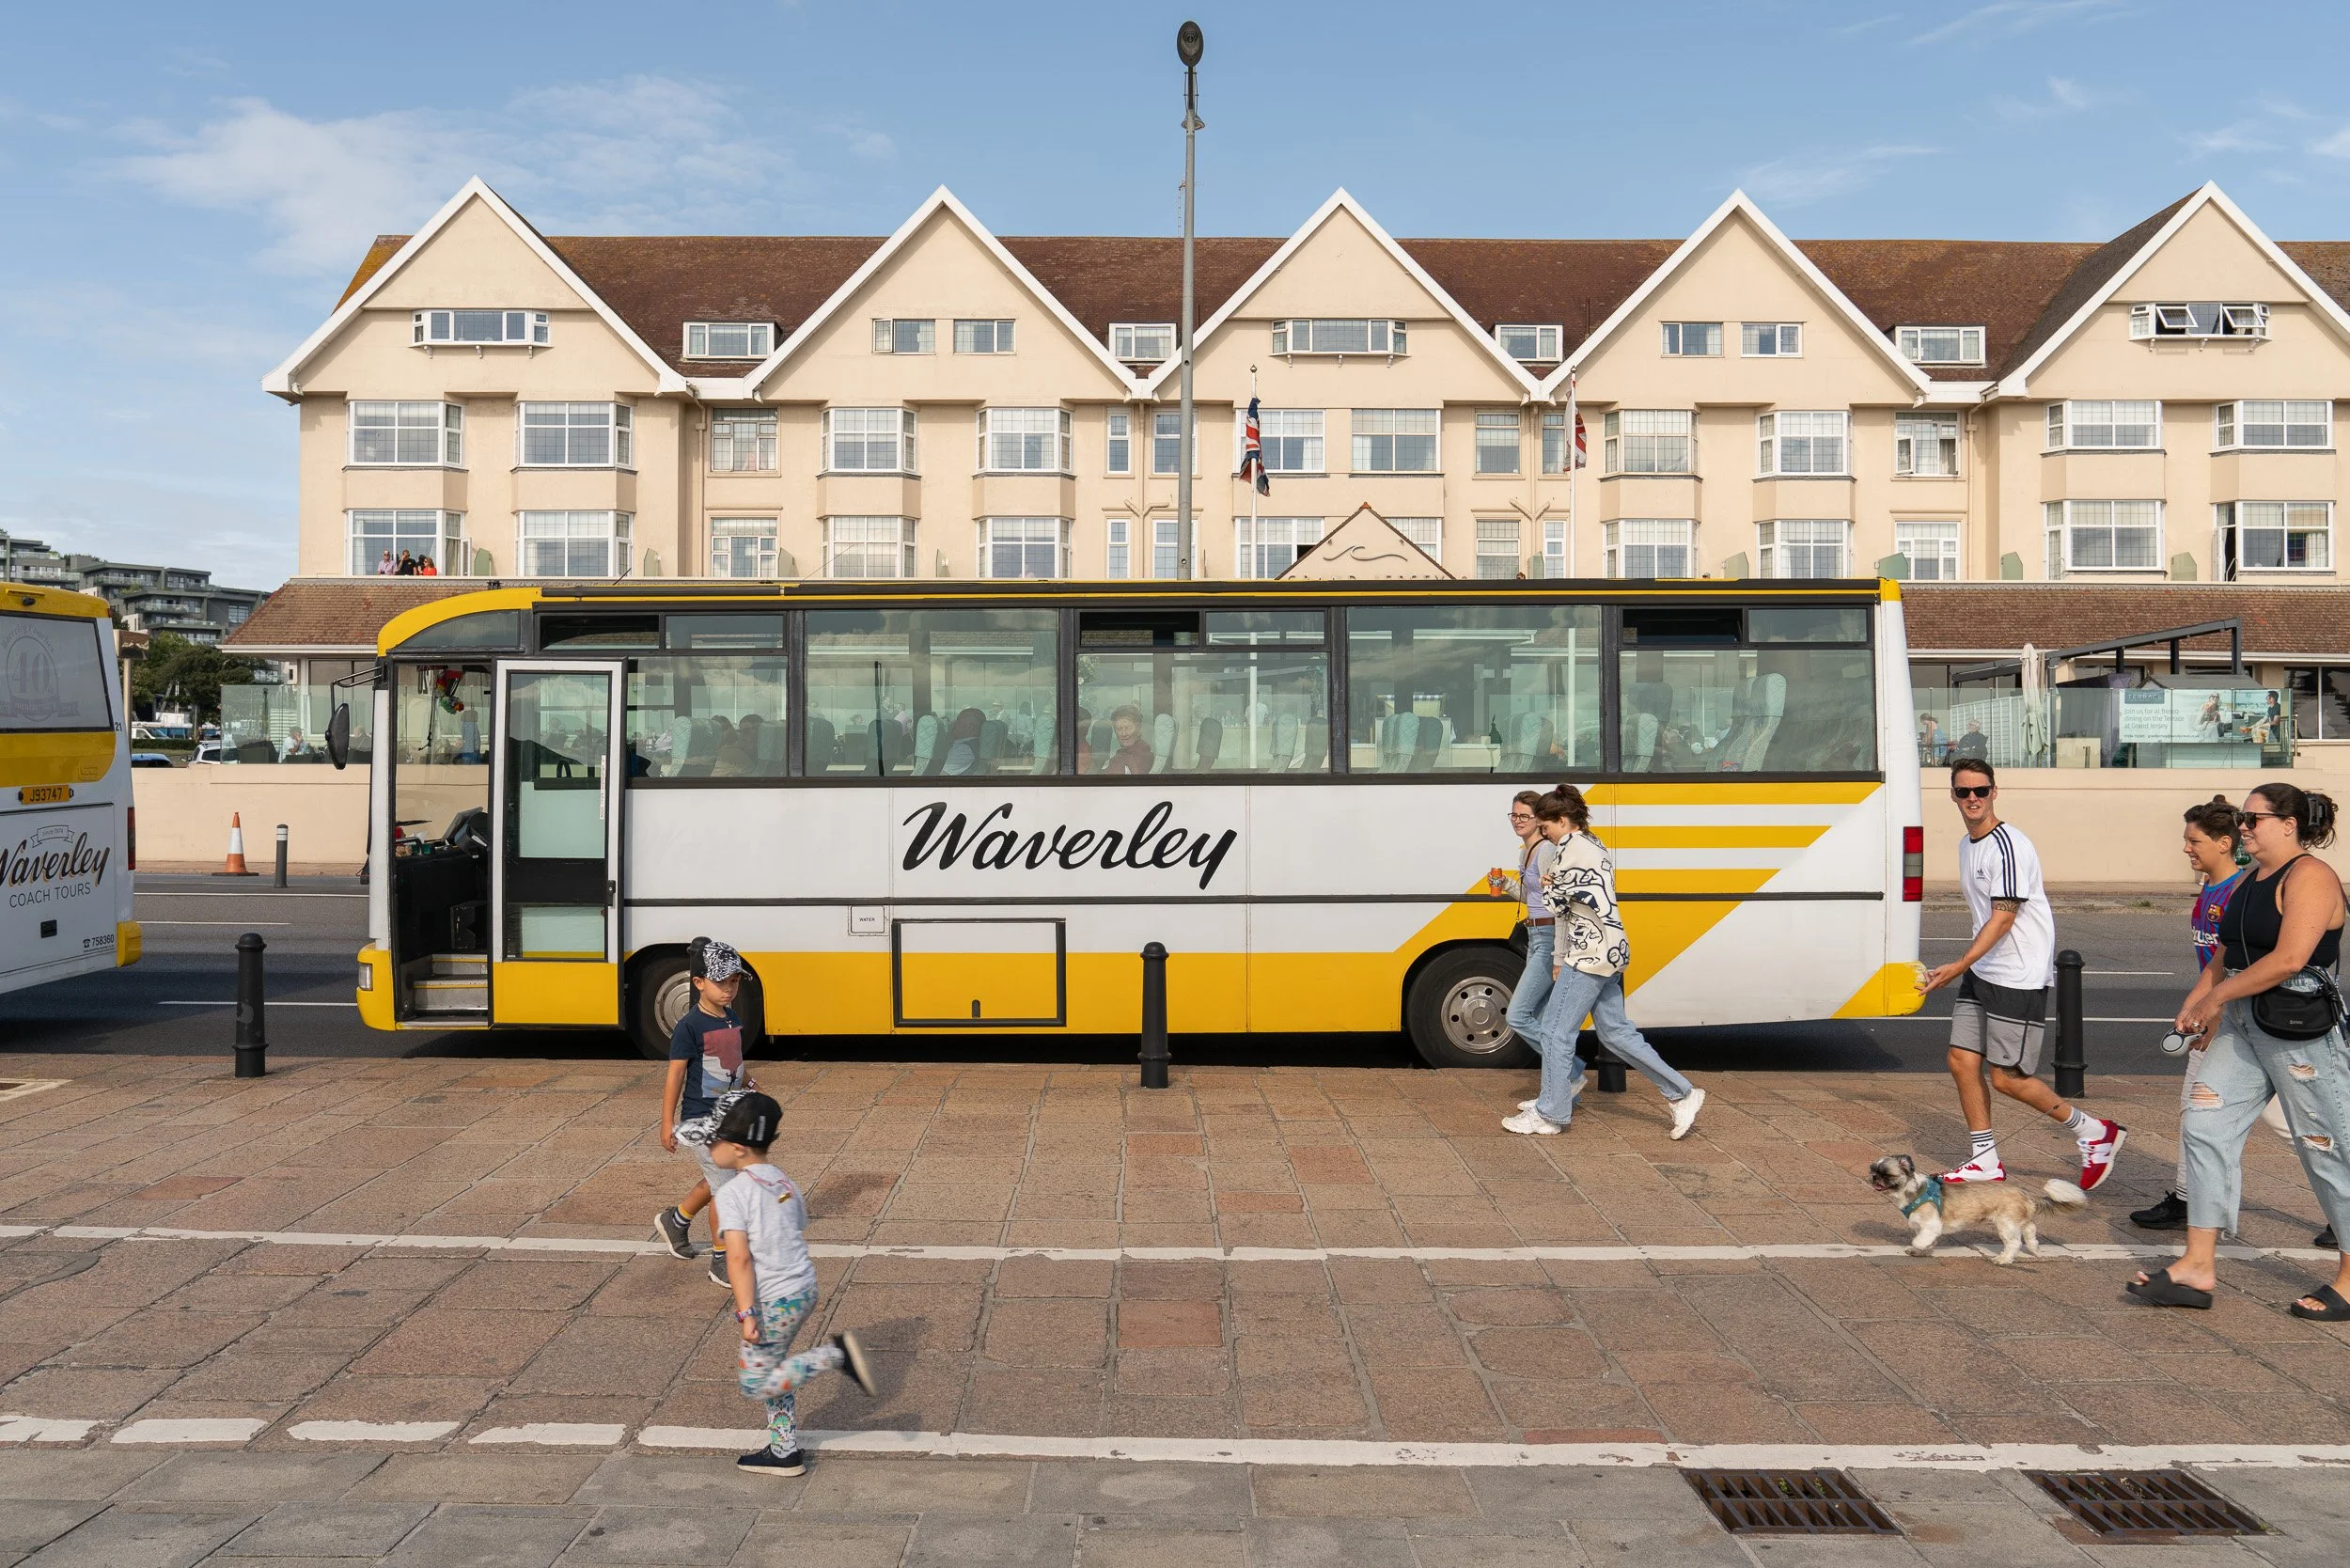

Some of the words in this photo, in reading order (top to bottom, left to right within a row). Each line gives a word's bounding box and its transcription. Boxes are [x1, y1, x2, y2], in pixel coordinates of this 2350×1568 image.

[114, 721, 122, 731] 21
[29, 788, 63, 802] J93747
[902, 801, 1238, 890] Waverley
[9, 888, 51, 908] COACH
[55, 882, 91, 900] TOURS
[91, 933, 115, 947] 758360
